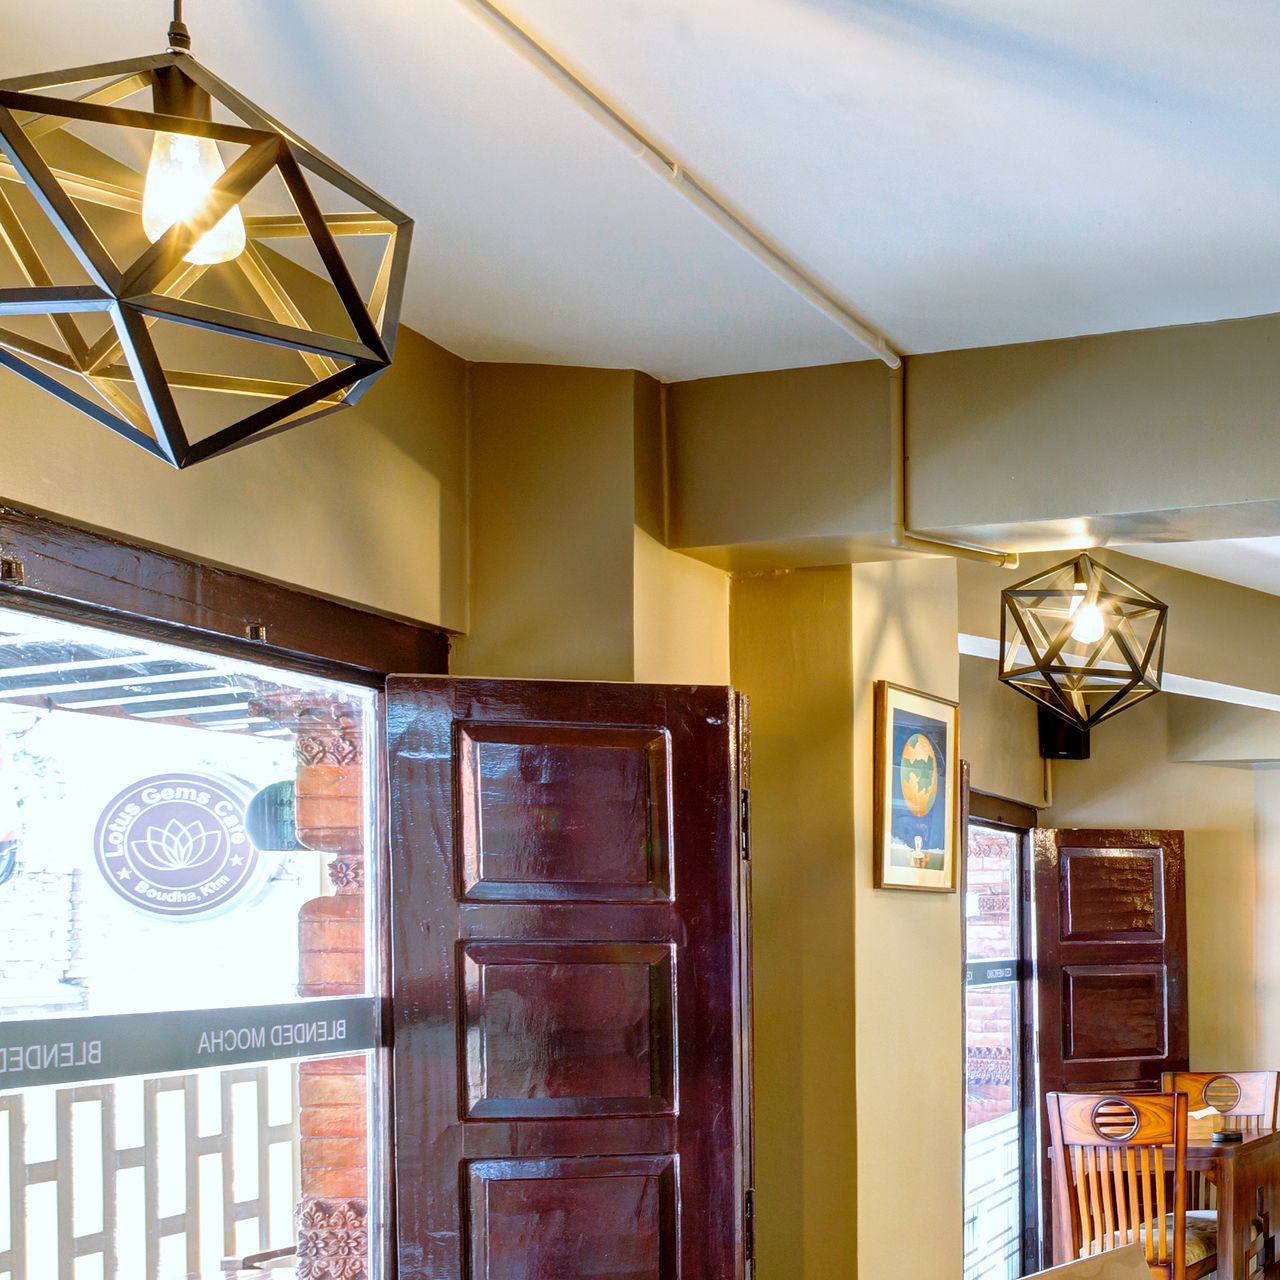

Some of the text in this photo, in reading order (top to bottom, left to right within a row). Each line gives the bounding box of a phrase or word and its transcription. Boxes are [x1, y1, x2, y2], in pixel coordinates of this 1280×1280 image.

[104, 786, 246, 858] Lotus Gems Cafe
[133, 874, 232, 903] Boudha, Ktm
